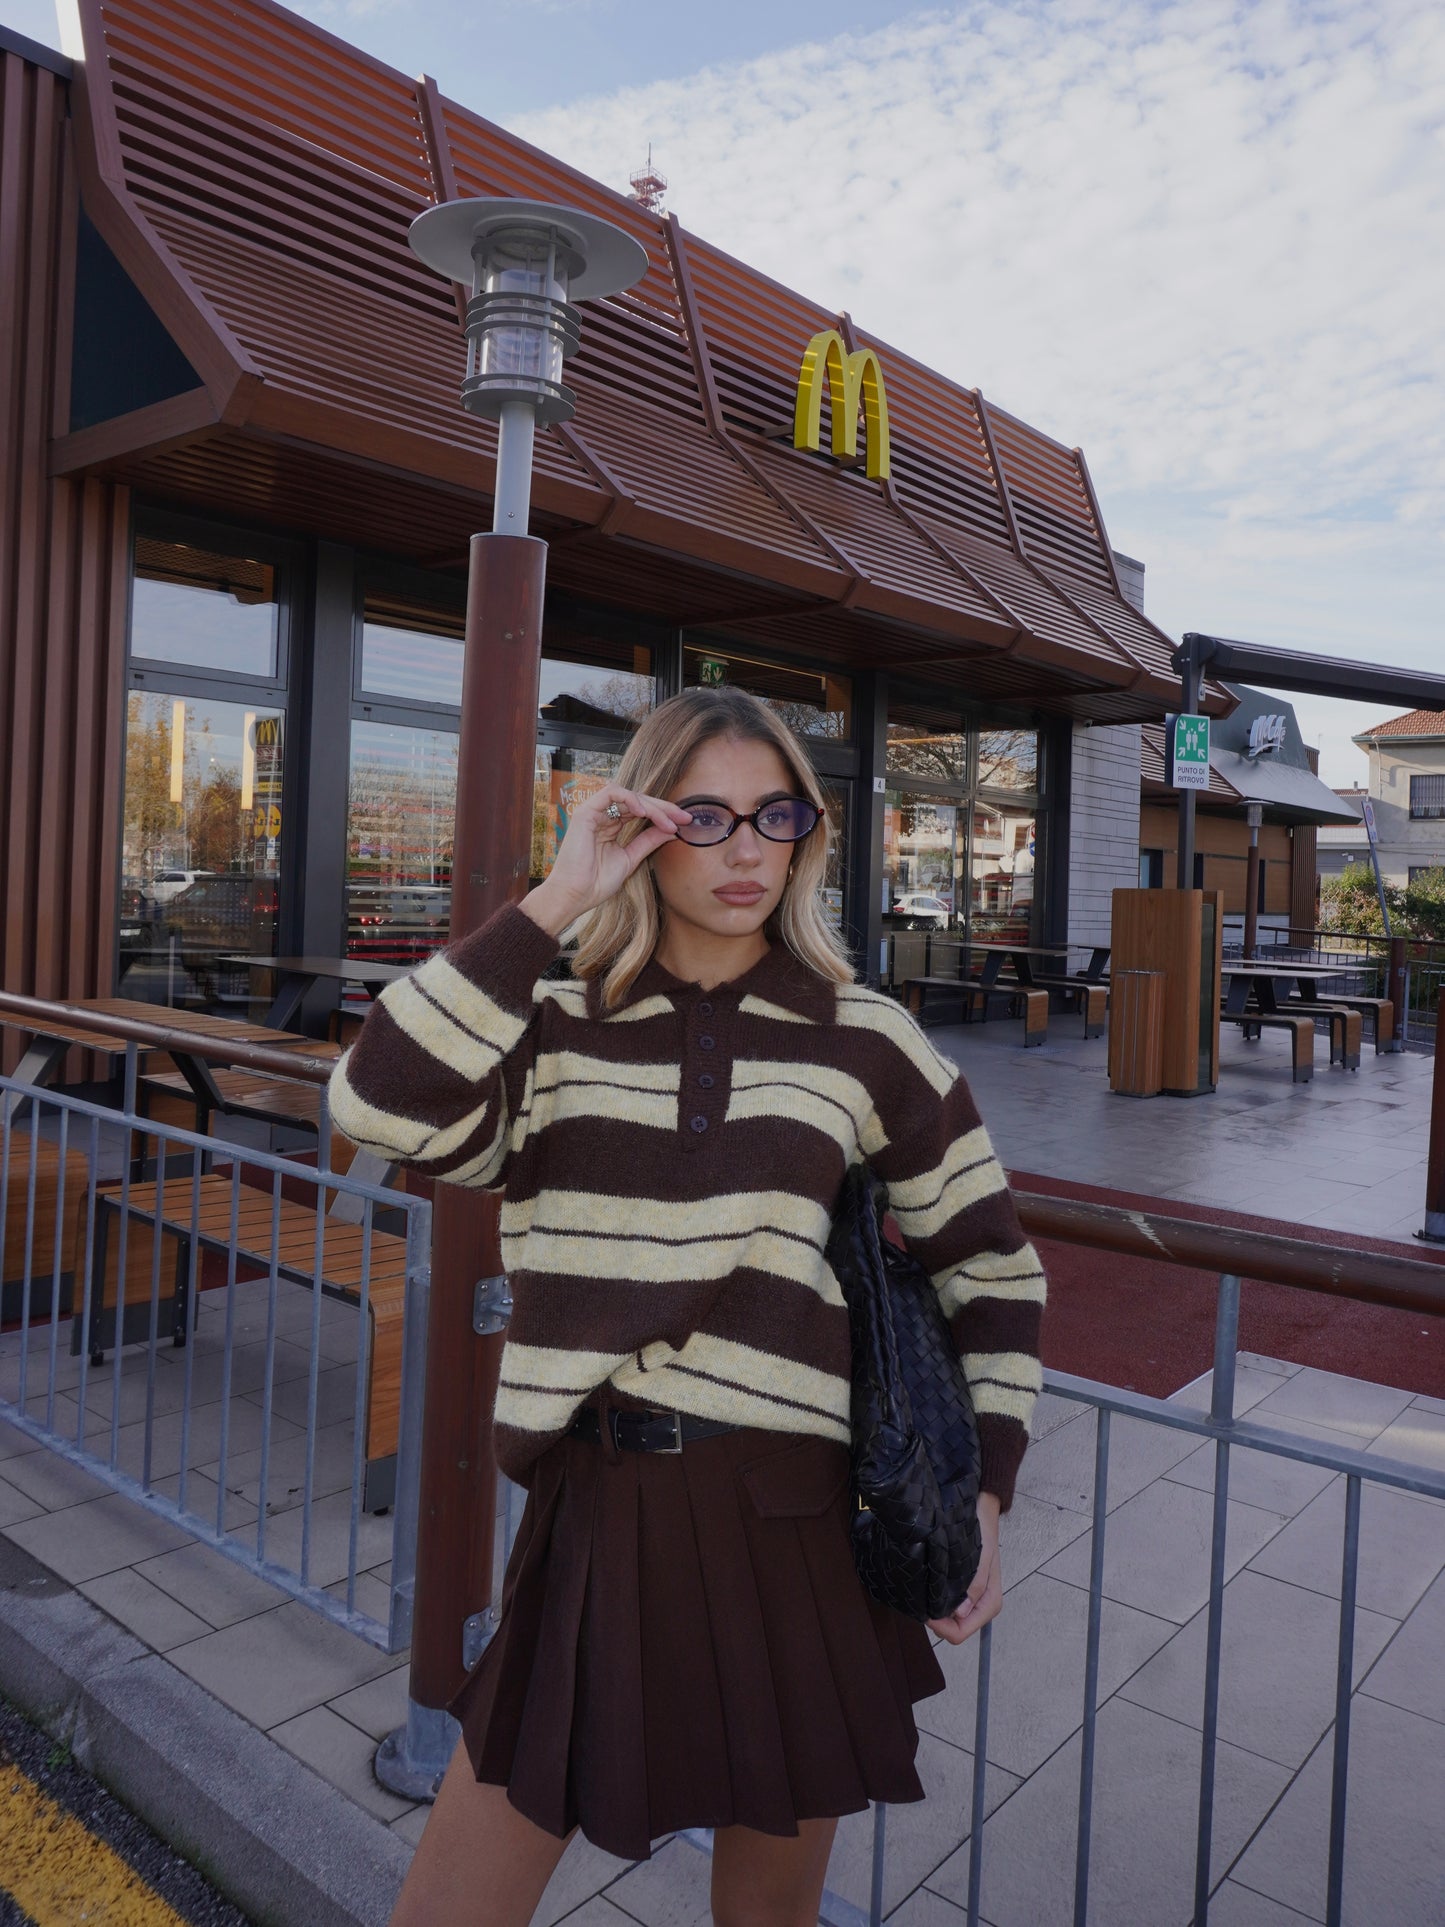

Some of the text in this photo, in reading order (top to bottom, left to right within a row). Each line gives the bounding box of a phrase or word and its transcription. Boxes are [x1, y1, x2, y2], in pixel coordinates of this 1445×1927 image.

[794, 329, 890, 480] M
[1178, 766, 1205, 775] PUNTO DI
[877, 779, 882, 790] 4
[1178, 775, 1205, 784] RITROVO
[560, 788, 593, 804] McCRU
